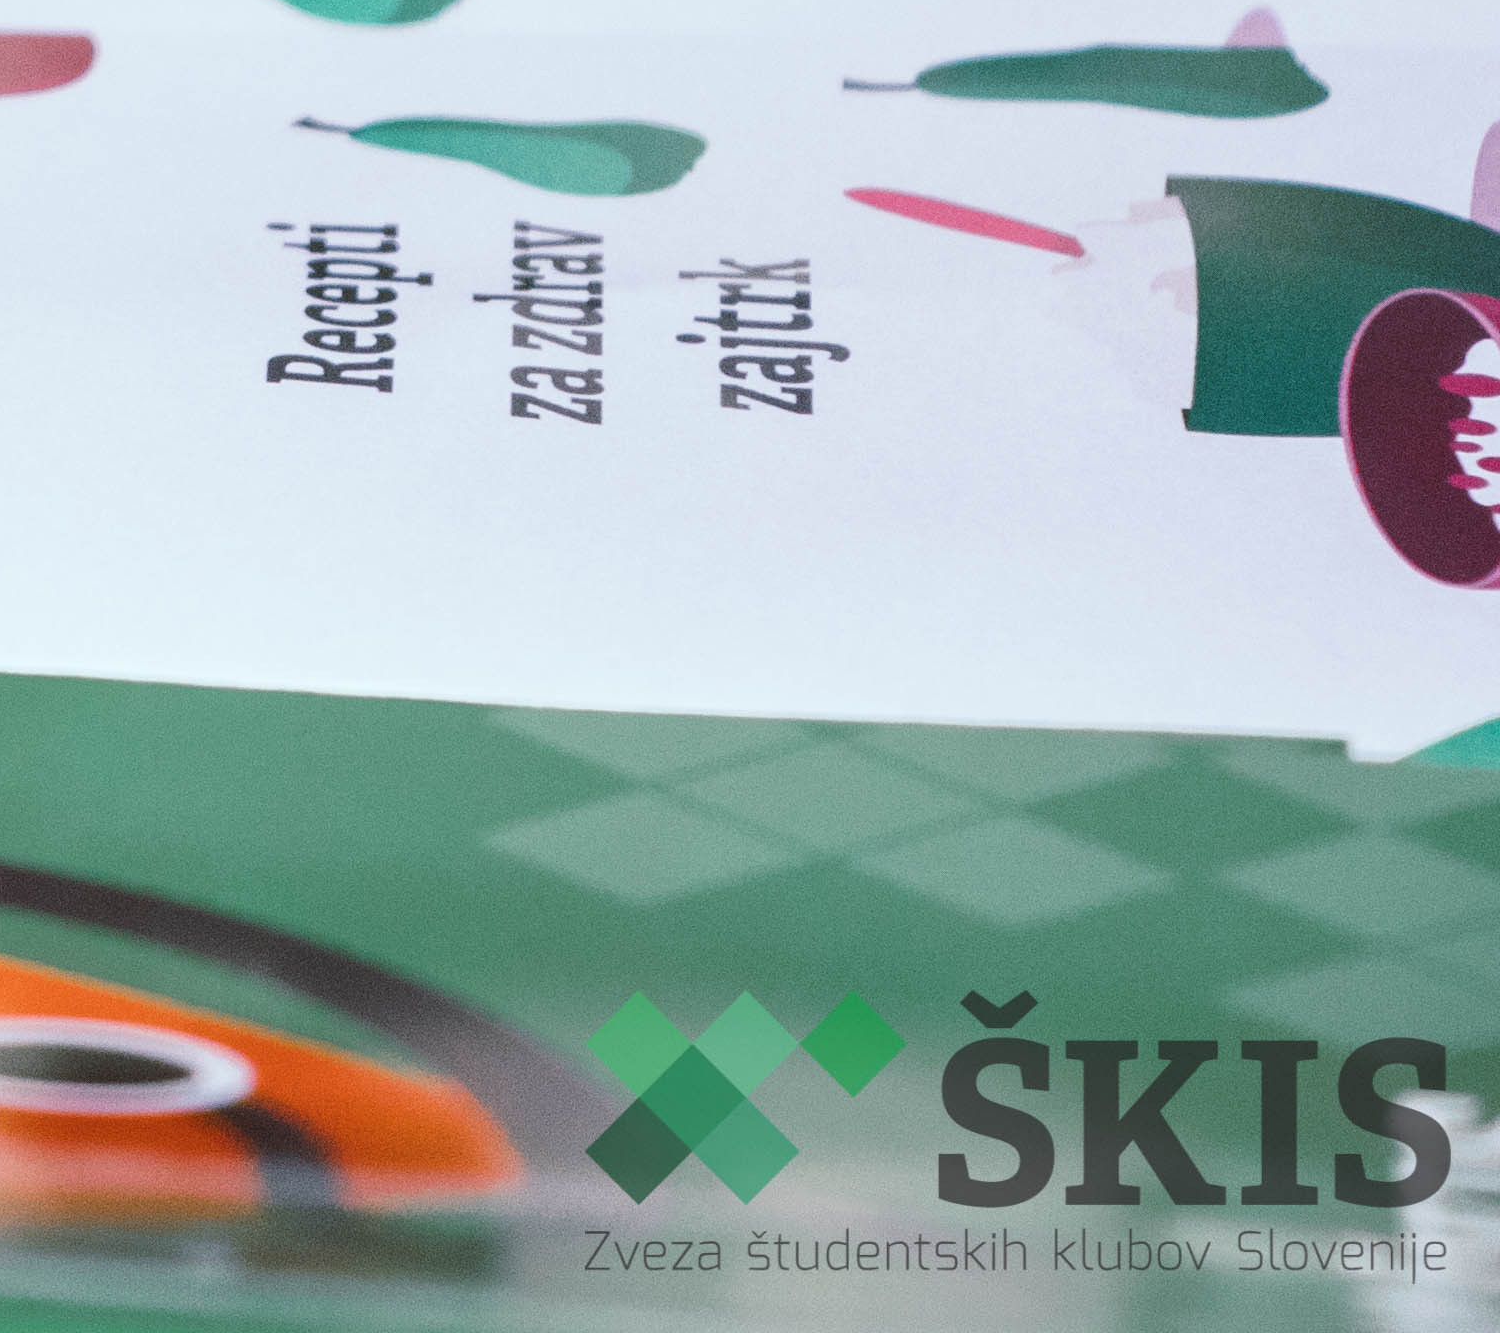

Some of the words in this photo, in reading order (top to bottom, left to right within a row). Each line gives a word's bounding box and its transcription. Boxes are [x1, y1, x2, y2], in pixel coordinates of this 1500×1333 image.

[265, 221, 434, 394] Recepti
[471, 220, 605, 357] zdrav
[675, 257, 852, 416] zajtrk
[509, 363, 605, 425] za
